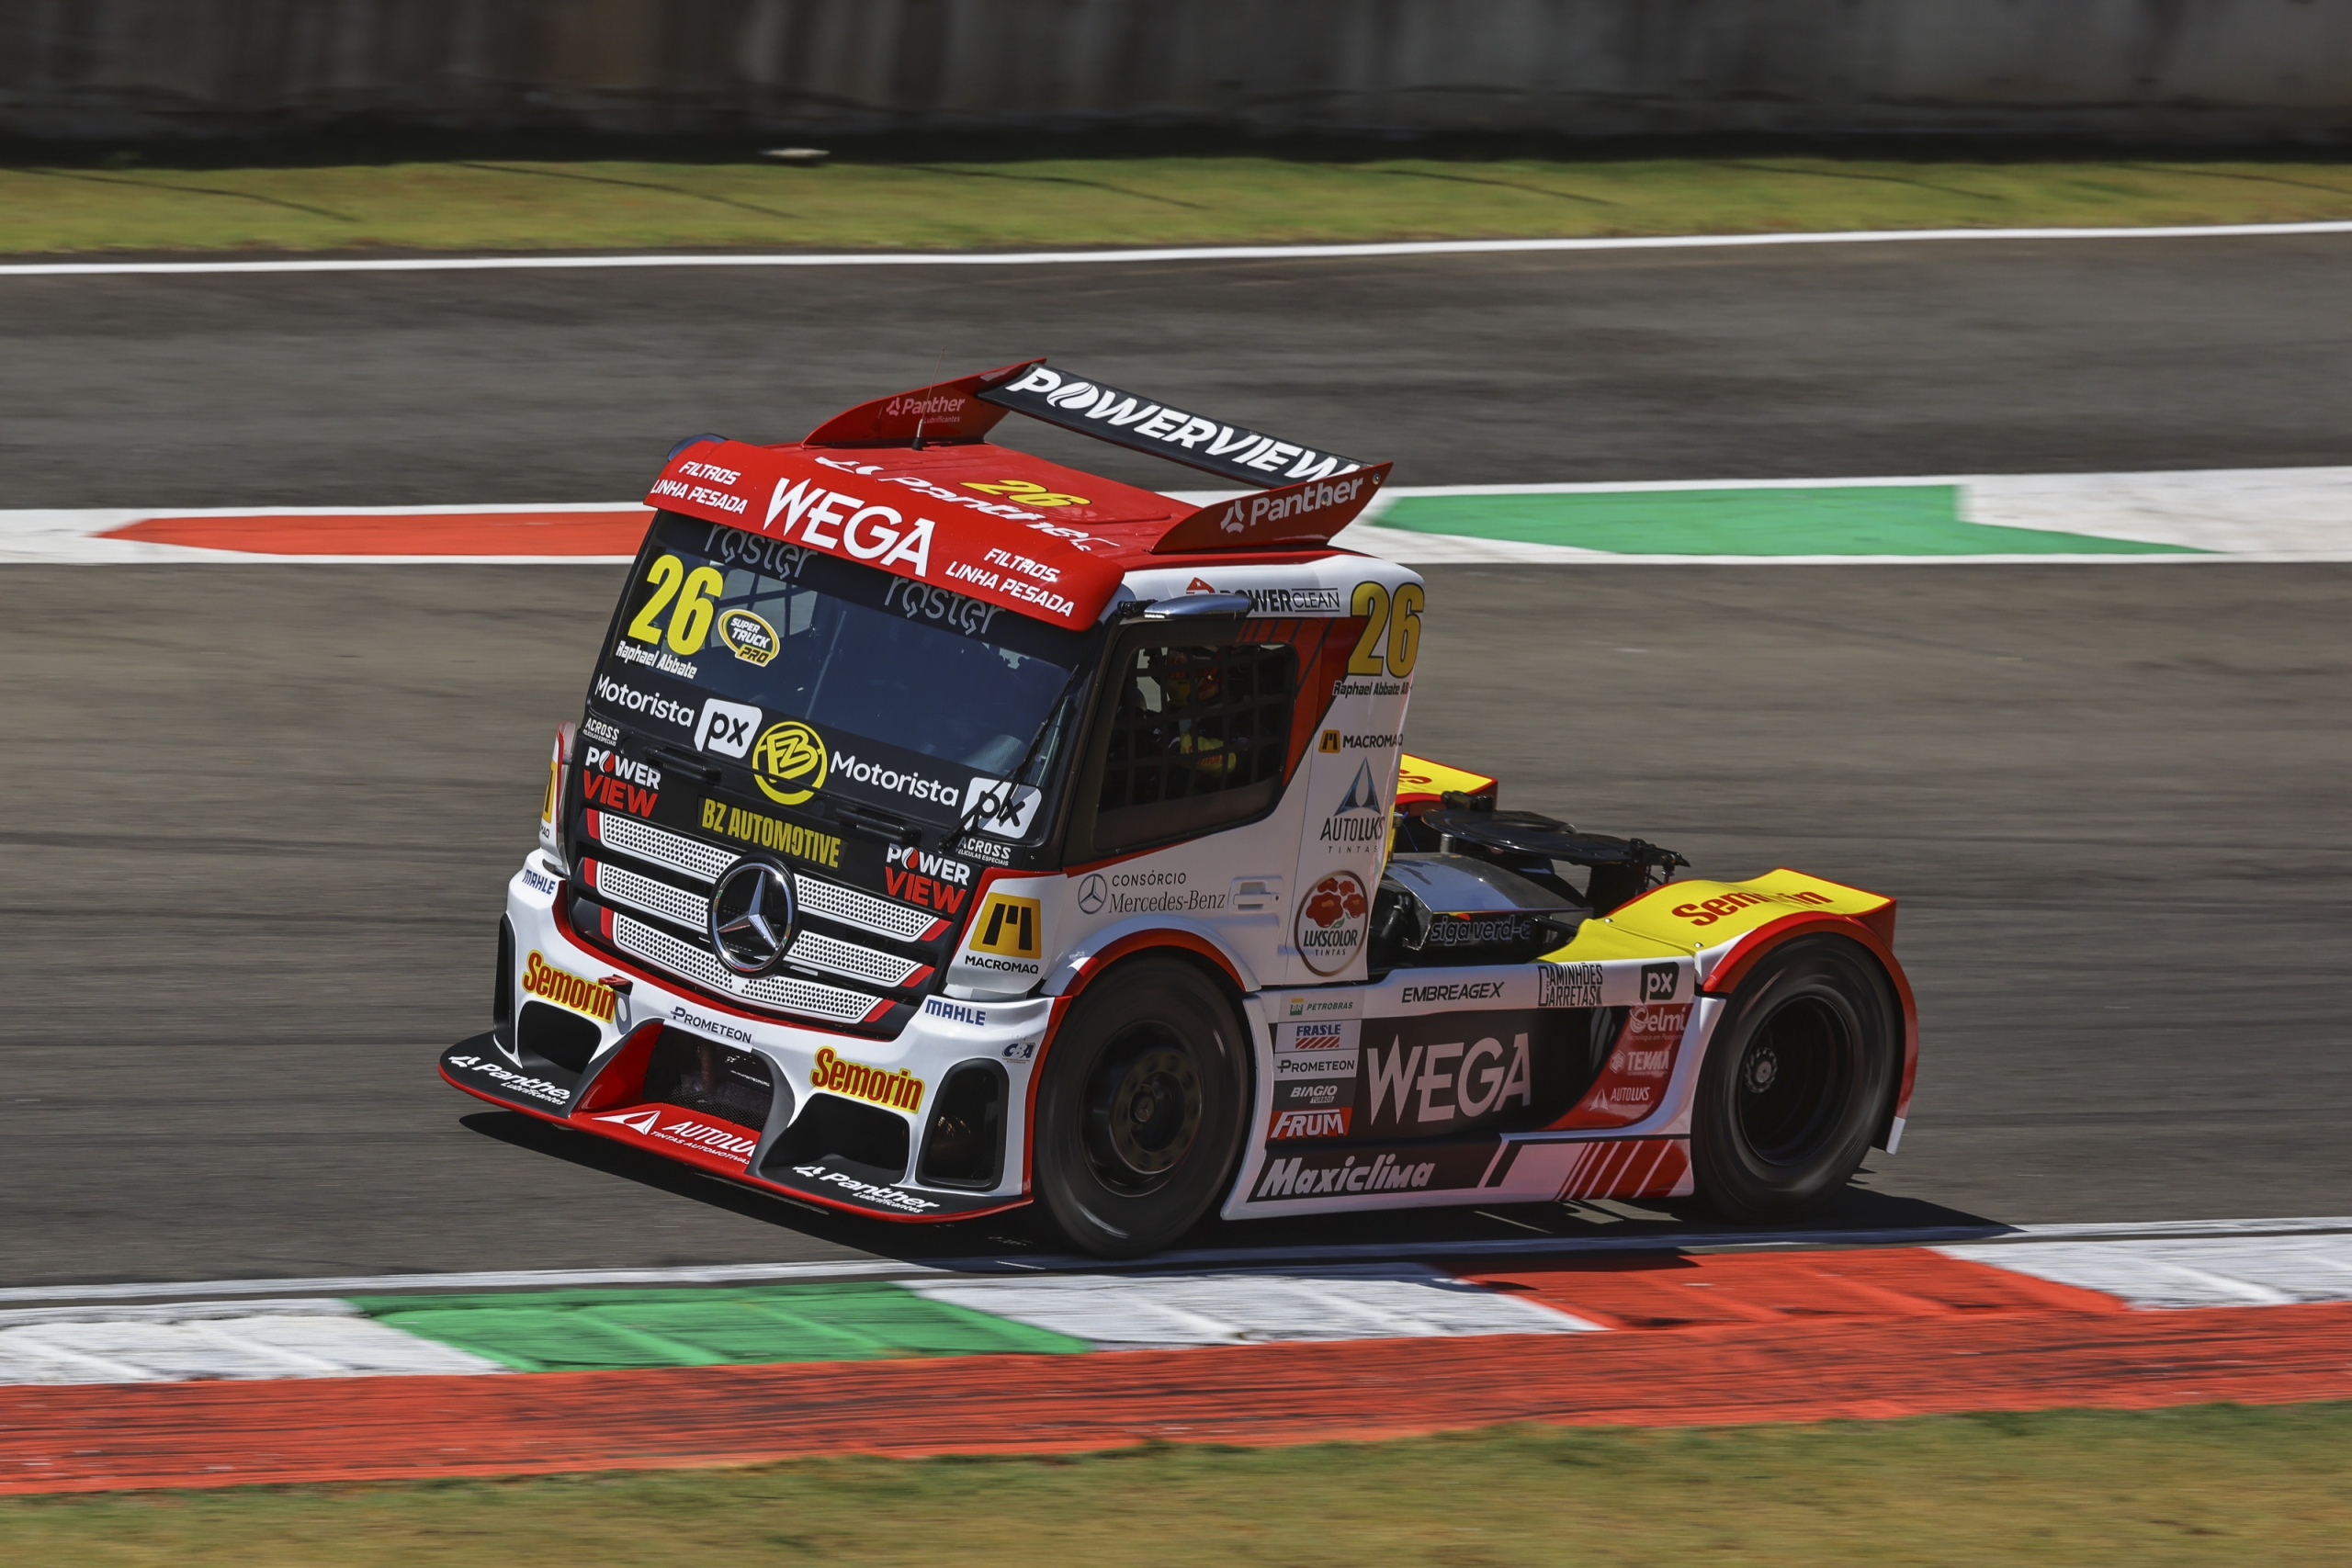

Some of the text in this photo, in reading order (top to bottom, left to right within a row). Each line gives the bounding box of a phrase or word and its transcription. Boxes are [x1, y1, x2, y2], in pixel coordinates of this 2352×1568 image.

[901, 396, 966, 415] Panther
[1005, 367, 1362, 483] POWERVIEW
[678, 460, 741, 486] FILTROS
[650, 479, 748, 515] LINHA PESADA
[958, 479, 1092, 507] 26
[1250, 477, 1363, 526] Panther
[763, 477, 936, 578] WEGA
[704, 524, 819, 580] raster
[983, 547, 1061, 583] FILTROS
[944, 560, 1075, 618] LINHA PESADA
[628, 554, 724, 656] 26
[884, 575, 1006, 636] raster
[730, 617, 761, 634] SUPER
[731, 627, 771, 649] TRUCK
[1347, 581, 1425, 679] 26
[616, 639, 698, 680] Raphael Abbate
[739, 647, 769, 664] PRO
[1333, 681, 1373, 698] Raphael
[1373, 682, 1400, 696] Abbate
[594, 673, 750, 750] Motorista px
[584, 717, 620, 741] ACROSS
[1342, 733, 1404, 749] MACROMAQ
[584, 746, 662, 790] POWER
[583, 769, 659, 818] VIEW
[830, 750, 1026, 829] Motorista px
[701, 798, 842, 868] BZ AUTOMOTIVE
[1319, 816, 1385, 841] AUTOLUKS
[957, 836, 1012, 860] ACROSS
[981, 854, 1010, 866] ESPECIAIS
[1329, 845, 1378, 853] TINTAS
[885, 842, 971, 886] POWER
[1112, 870, 1187, 887] CONSÓRCIO
[521, 869, 557, 896] MAHLE
[885, 865, 967, 915] VIEW
[1108, 889, 1226, 914] Mercedes-Benz
[1303, 929, 1359, 948] LUKSCOLOR
[1430, 915, 1471, 947] siga
[964, 954, 1039, 976] MACROMAQ
[1315, 948, 1347, 957] TINTAS
[524, 952, 617, 1022] Semorin
[1401, 981, 1505, 1004] EMBREAGEX
[1645, 971, 1674, 999] px
[924, 998, 987, 1027] MAHLE
[1306, 1001, 1354, 1011] PETROBRAS
[670, 1006, 752, 1044] PROMETEON
[1002, 1043, 1035, 1059] CBA
[811, 1047, 924, 1111] Semorin
[1276, 1059, 1355, 1074] PROMETEON
[1366, 1032, 1532, 1126] WEGA
[471, 1063, 571, 1100] Panthe
[500, 1081, 566, 1105] Lubrificantes
[1290, 1085, 1338, 1098] BIAGIO
[1611, 1087, 1651, 1102] AUTOLUKS
[1270, 1109, 1344, 1139] FRUM
[650, 1131, 751, 1165] TINTAS AUTOMOTIVAS
[662, 1121, 756, 1157] AUTOLU
[819, 1172, 941, 1208] Panther
[1256, 1153, 1436, 1198] Maxiclima
[852, 1191, 924, 1213] Lubrificantes
